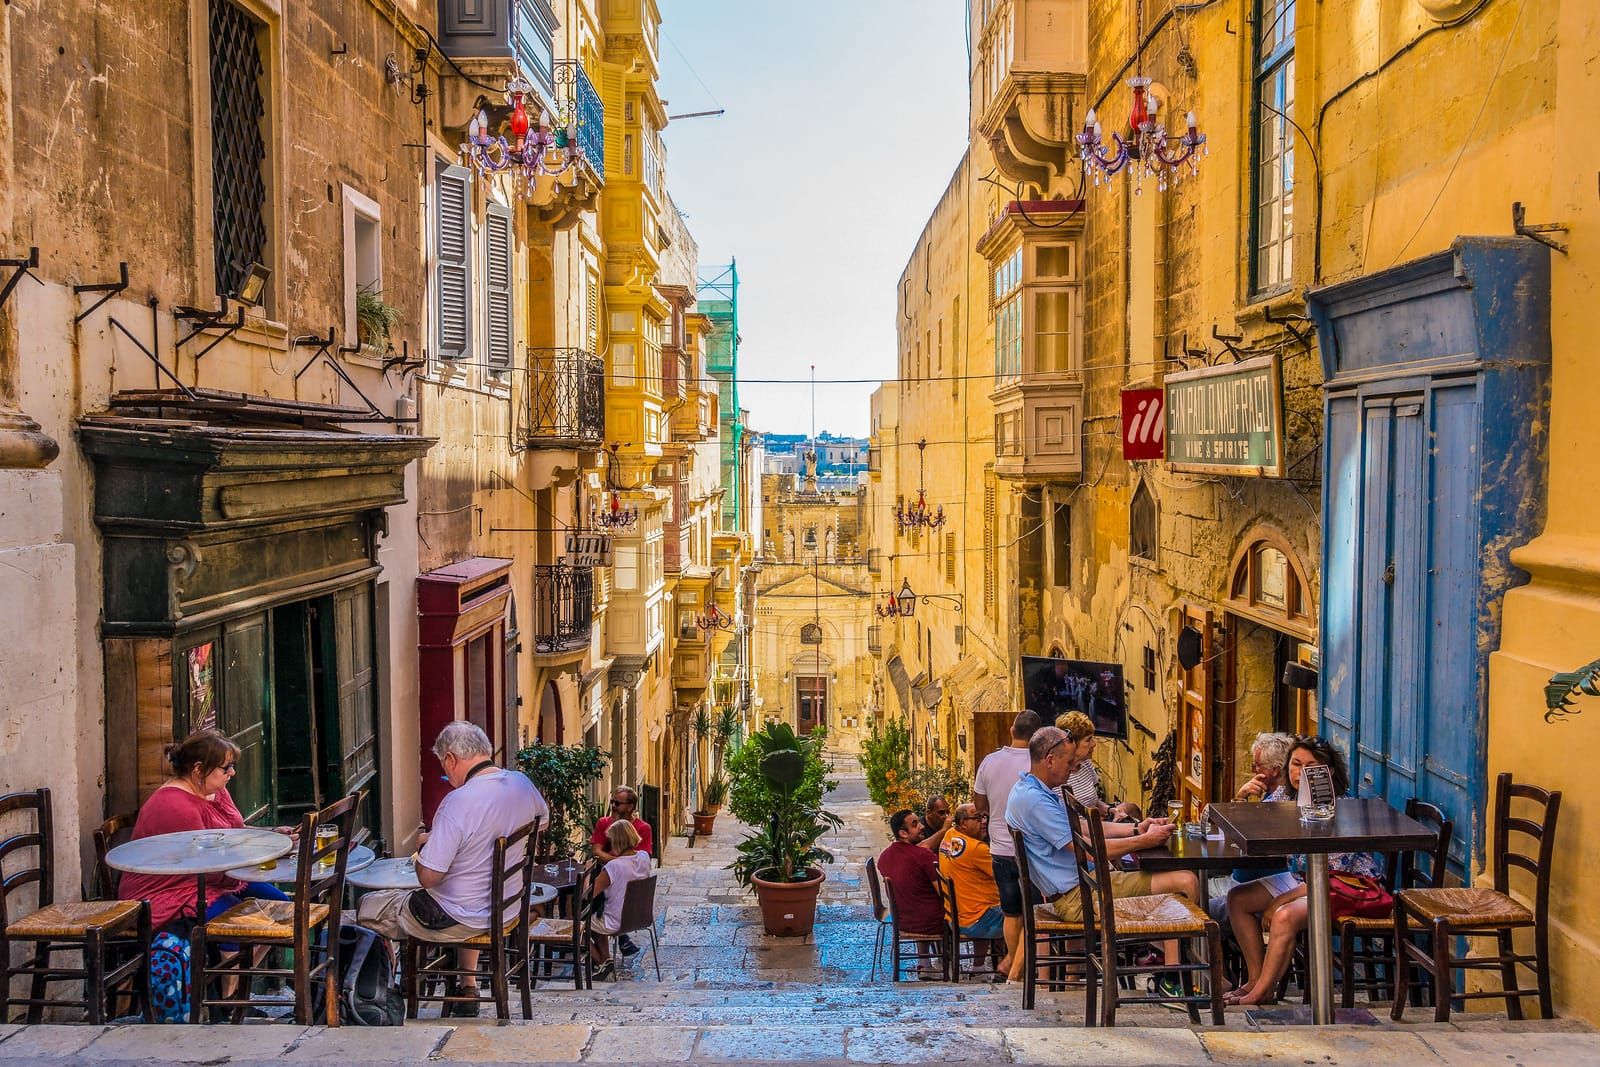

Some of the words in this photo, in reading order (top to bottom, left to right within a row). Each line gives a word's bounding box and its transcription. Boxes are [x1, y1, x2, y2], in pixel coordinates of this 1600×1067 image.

[1127, 397, 1164, 449] ill
[1170, 387, 1185, 435] SAN
[1187, 384, 1215, 435] PAOLO
[1216, 375, 1271, 434] NAUFRAGO
[1185, 440, 1203, 458] WINE
[1205, 441, 1211, 458] &
[1213, 440, 1249, 460] SPIRITS
[574, 555, 604, 565] office
